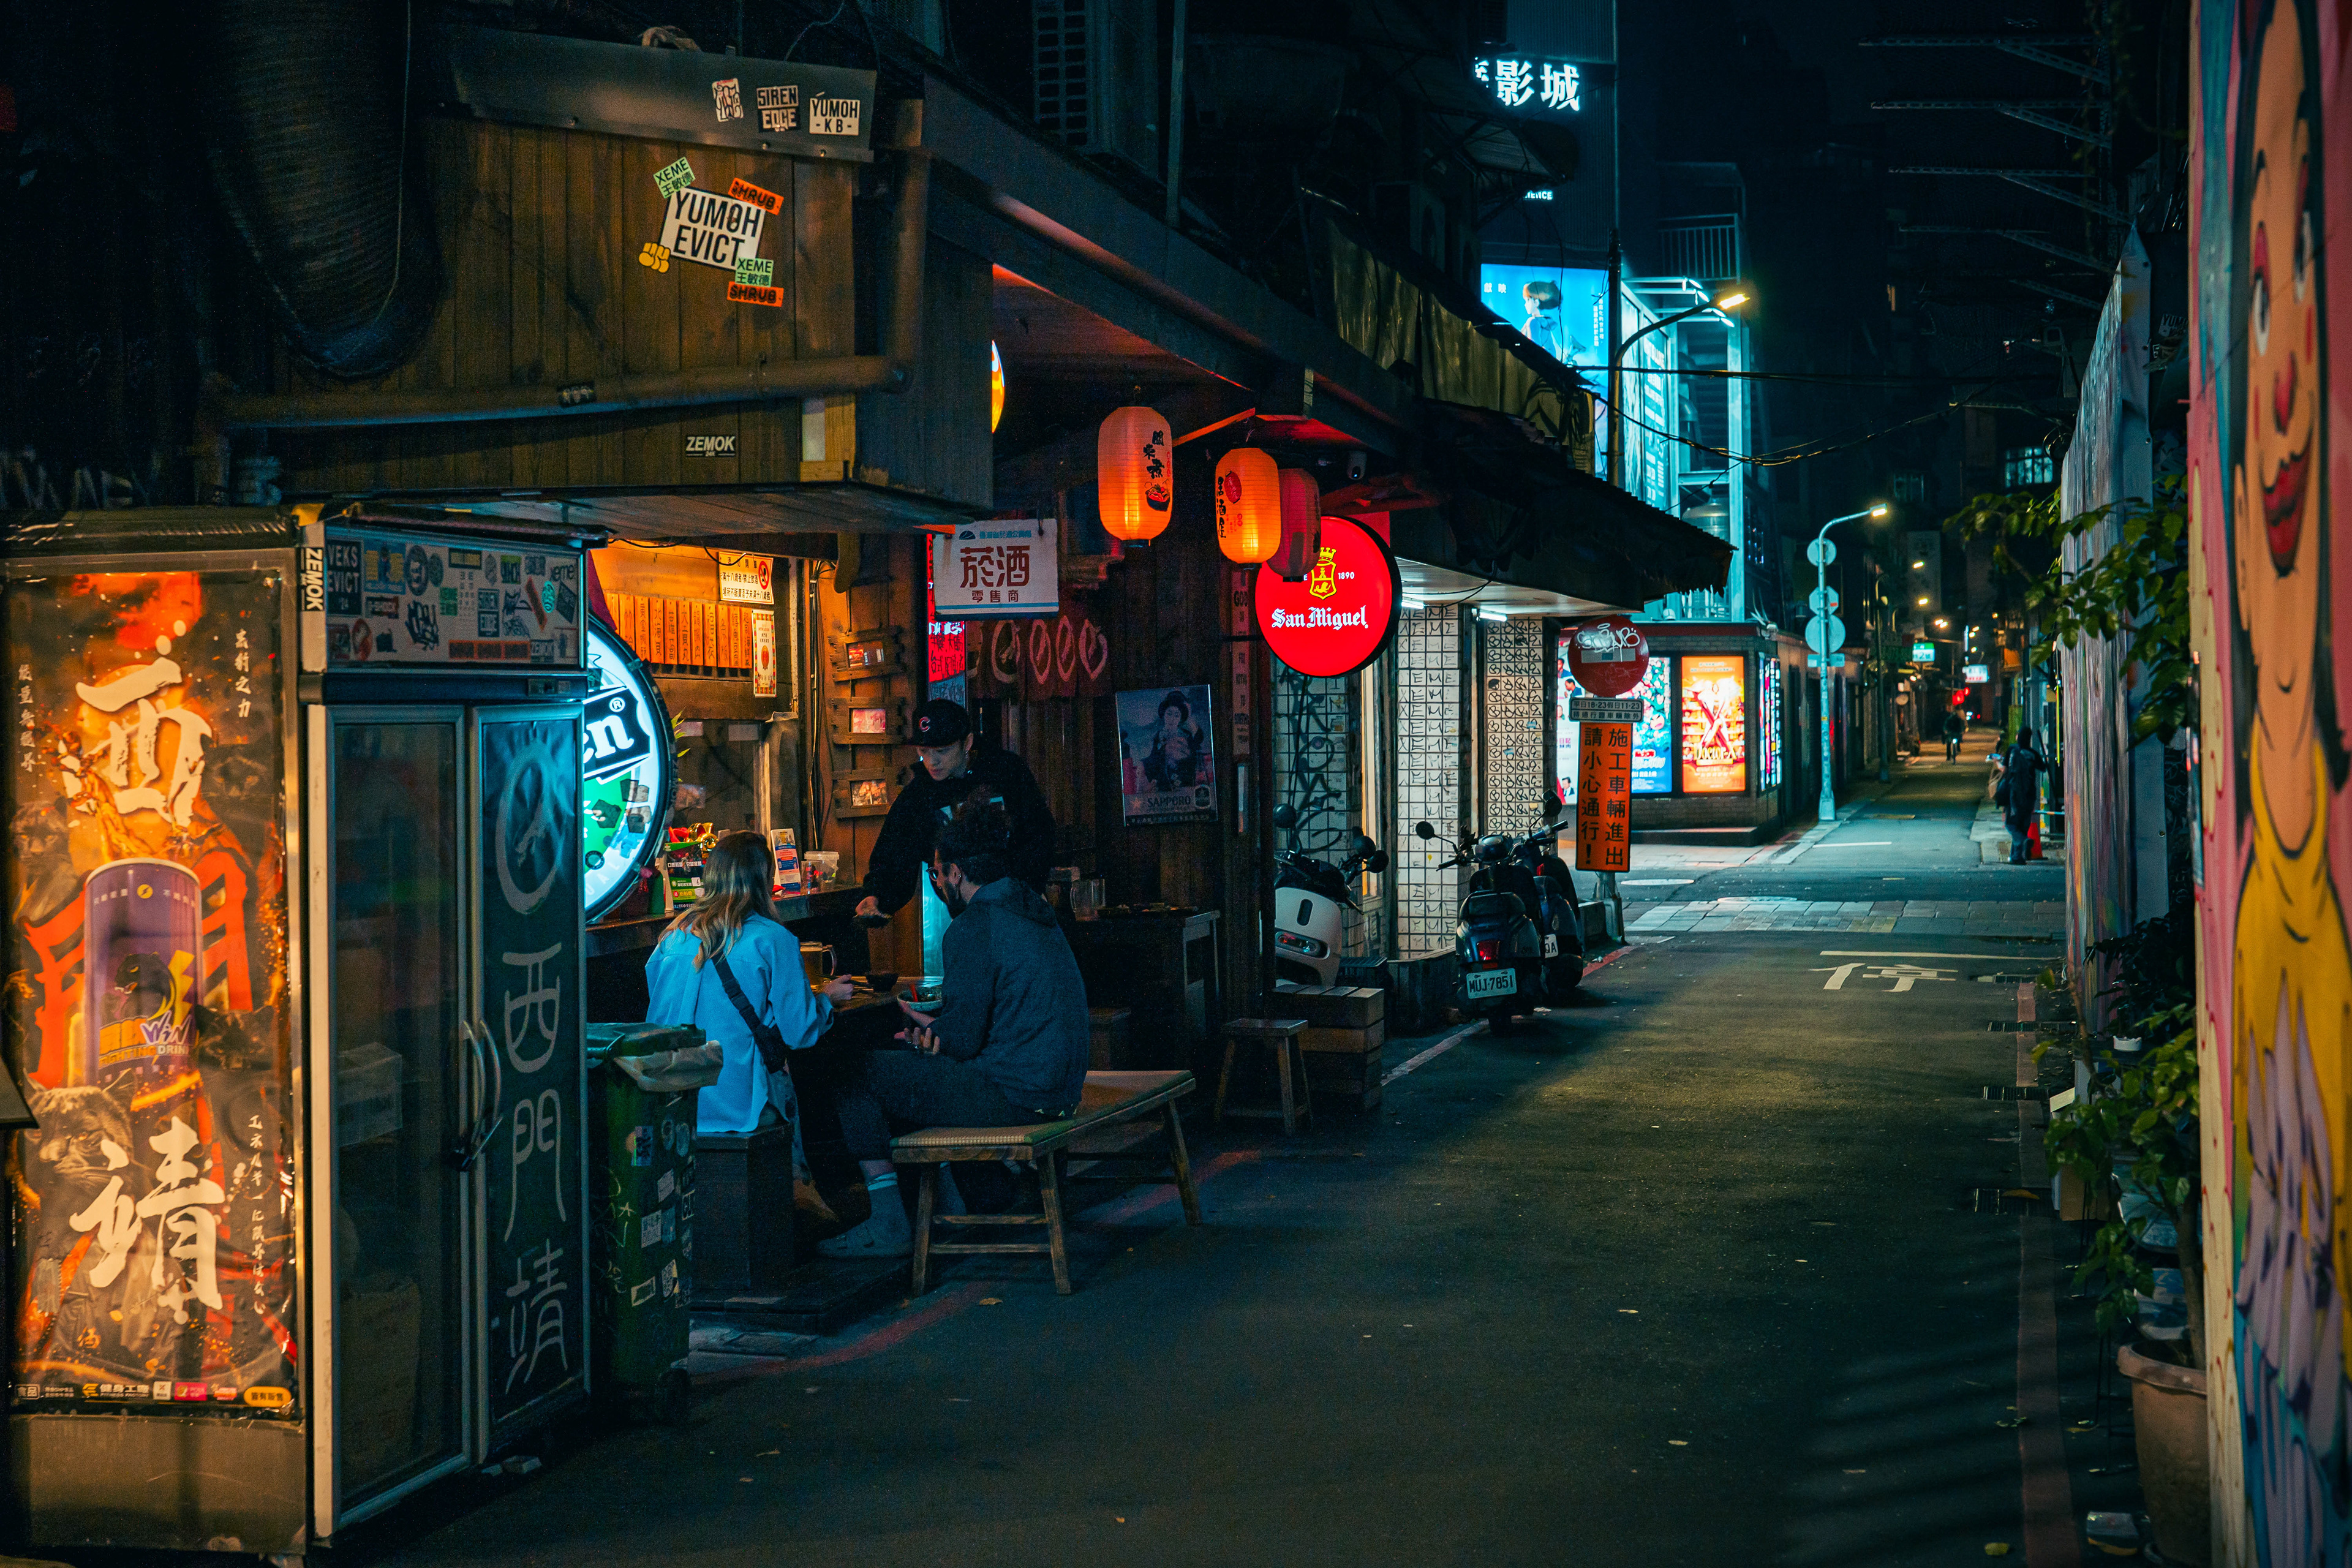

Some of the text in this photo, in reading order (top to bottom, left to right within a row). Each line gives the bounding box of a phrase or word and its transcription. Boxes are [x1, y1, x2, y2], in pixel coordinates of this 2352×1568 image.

[758, 88, 798, 107] SIREN
[812, 100, 859, 119] YUMOH
[655, 159, 690, 186] XEME
[731, 179, 777, 210] SHRUB
[675, 191, 762, 238] YUMOH
[674, 225, 745, 267] EVICT
[737, 258, 772, 273] XEME
[737, 273, 771, 285] 王敏德
[729, 285, 777, 303] SHRUB
[685, 435, 736, 451] ZEMOK
[326, 543, 359, 568] VEKS
[960, 545, 1030, 588] 菸酒
[305, 547, 324, 611] ZEMOK
[326, 570, 360, 593] EVICT
[971, 589, 1019, 603] 零售商
[1272, 608, 1305, 628] San
[1147, 796, 1191, 807] SAPPORO
[1605, 728, 1629, 866] 施工車輛進出
[1469, 975, 1513, 993] MUJ-7851
